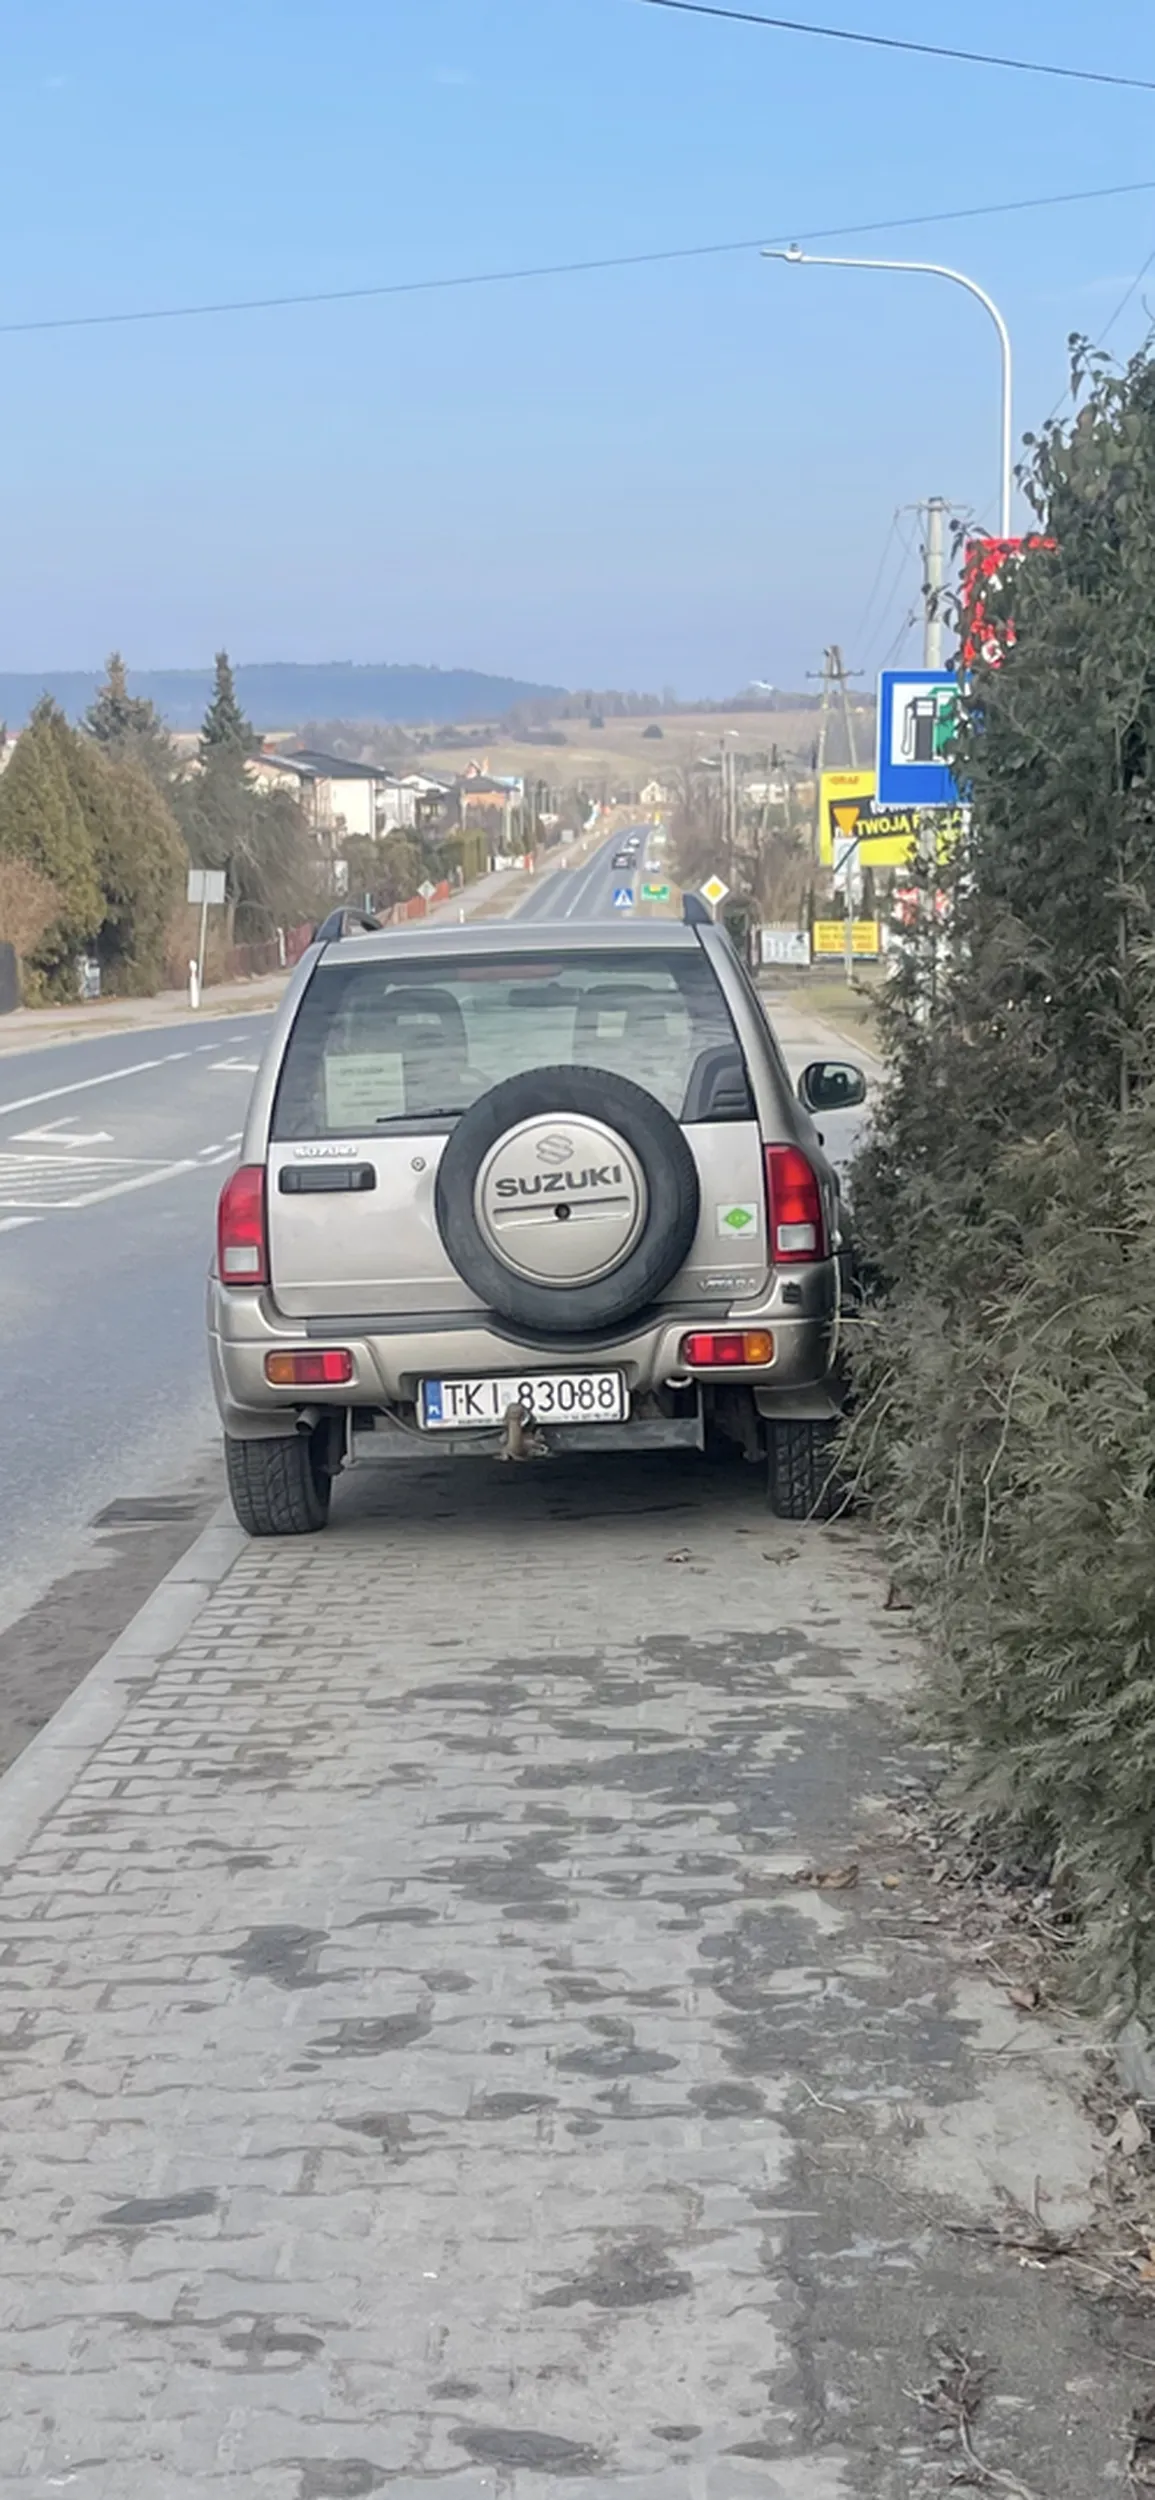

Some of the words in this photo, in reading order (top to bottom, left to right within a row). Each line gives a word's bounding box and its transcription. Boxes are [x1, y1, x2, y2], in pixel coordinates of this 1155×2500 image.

[495, 1164, 622, 1197] SUZUKI
[444, 1382, 499, 1416] TKI
[517, 1377, 615, 1412] 83088
